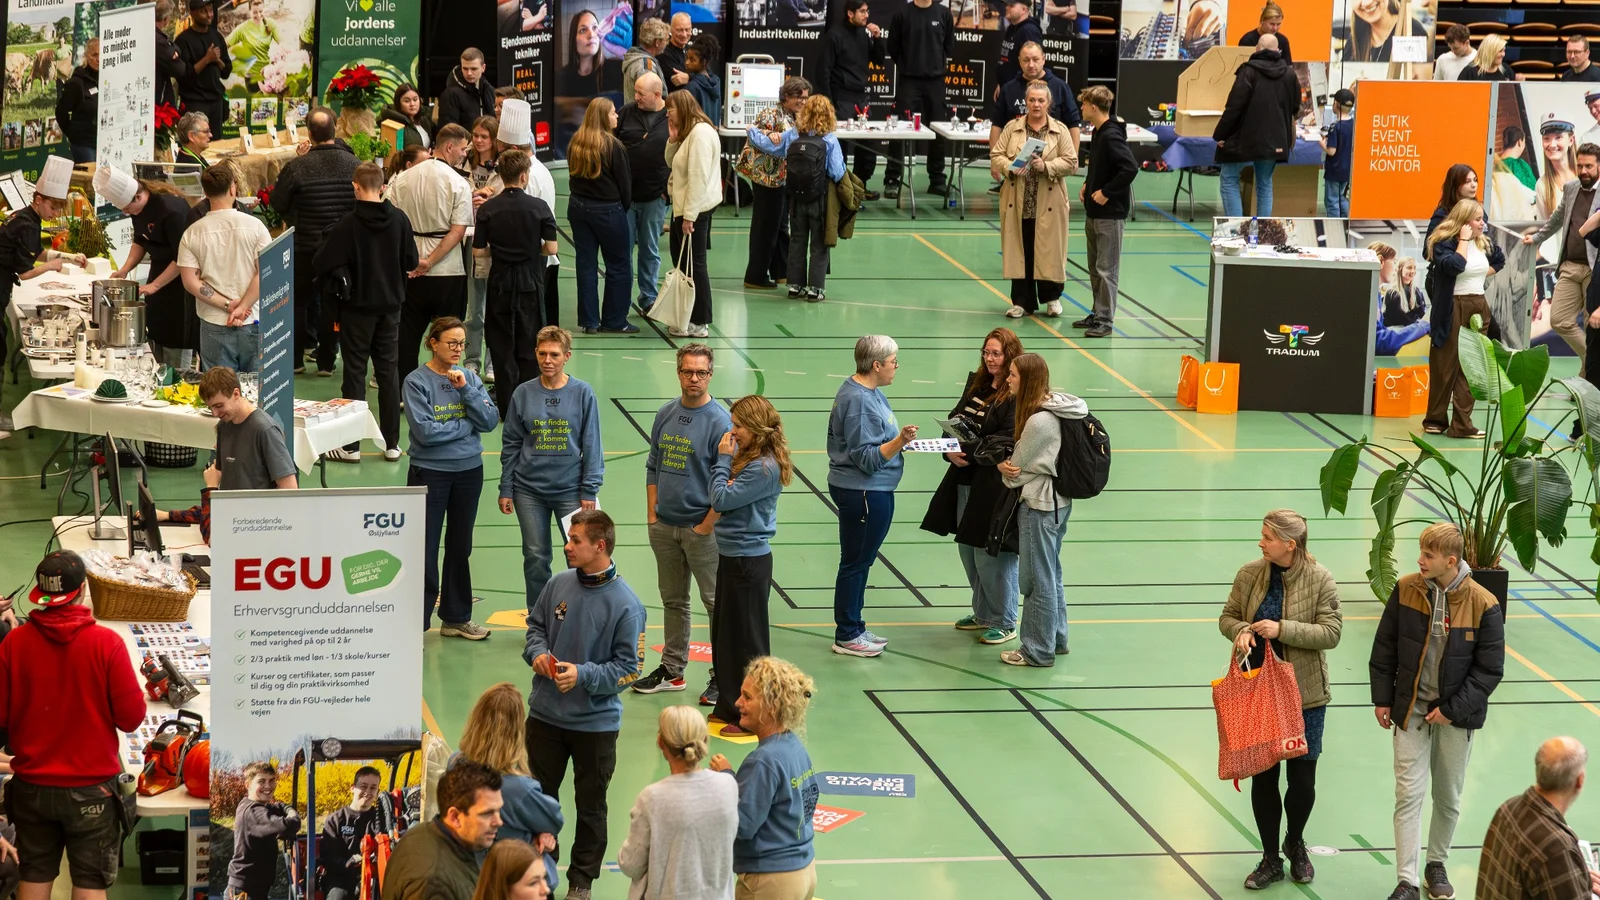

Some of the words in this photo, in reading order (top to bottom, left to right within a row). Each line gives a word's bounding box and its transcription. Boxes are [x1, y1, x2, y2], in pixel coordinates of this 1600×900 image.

[346, 0, 358, 12] Vi
[374, 0, 396, 12] alle
[345, 17, 395, 31] jordens
[103, 29, 114, 40] Alle
[331, 34, 406, 46] uddannelser
[740, 28, 820, 40] Industritekniker
[110, 40, 128, 52] mindst
[129, 40, 136, 48] en
[502, 32, 552, 49] Ejendomsservice-
[1042, 40, 1072, 51] energi
[515, 48, 540, 60] tekniker
[102, 57, 116, 69] gang
[120, 52, 132, 63] livet
[516, 68, 535, 79] REAL.
[950, 64, 974, 73] EAL.
[962, 88, 978, 96] 1828
[1373, 115, 1409, 127] BUTIK
[1372, 130, 1412, 142] EVENT
[1371, 144, 1420, 157] HANDEL
[1370, 159, 1420, 172] KONTOR
[1266, 348, 1320, 356] TRADIUM
[663, 433, 674, 441] Der
[675, 435, 692, 444] findes
[558, 443, 567, 451] på
[364, 513, 405, 529] FGU
[232, 524, 293, 534] grunduddannelse
[235, 556, 332, 591] EGU
[352, 574, 379, 585] ARBEJDE
[234, 601, 394, 618] Erhvervsgrunduddannelsen
[250, 628, 328, 638] Kompetencegivende
[331, 626, 373, 634] uddannelse
[269, 638, 303, 647] varighed
[304, 637, 314, 646] på
[265, 654, 291, 664] praktik
[294, 653, 310, 661] med
[345, 652, 390, 660] skole/kurser
[289, 671, 332, 679] certifikater,
[352, 670, 375, 678] passer
[260, 682, 272, 691] dig
[300, 679, 370, 689] praktikvirksomhed
[303, 696, 353, 705] FGU-vejleder
[251, 708, 271, 717] vejen
[1286, 738, 1306, 750] OK
